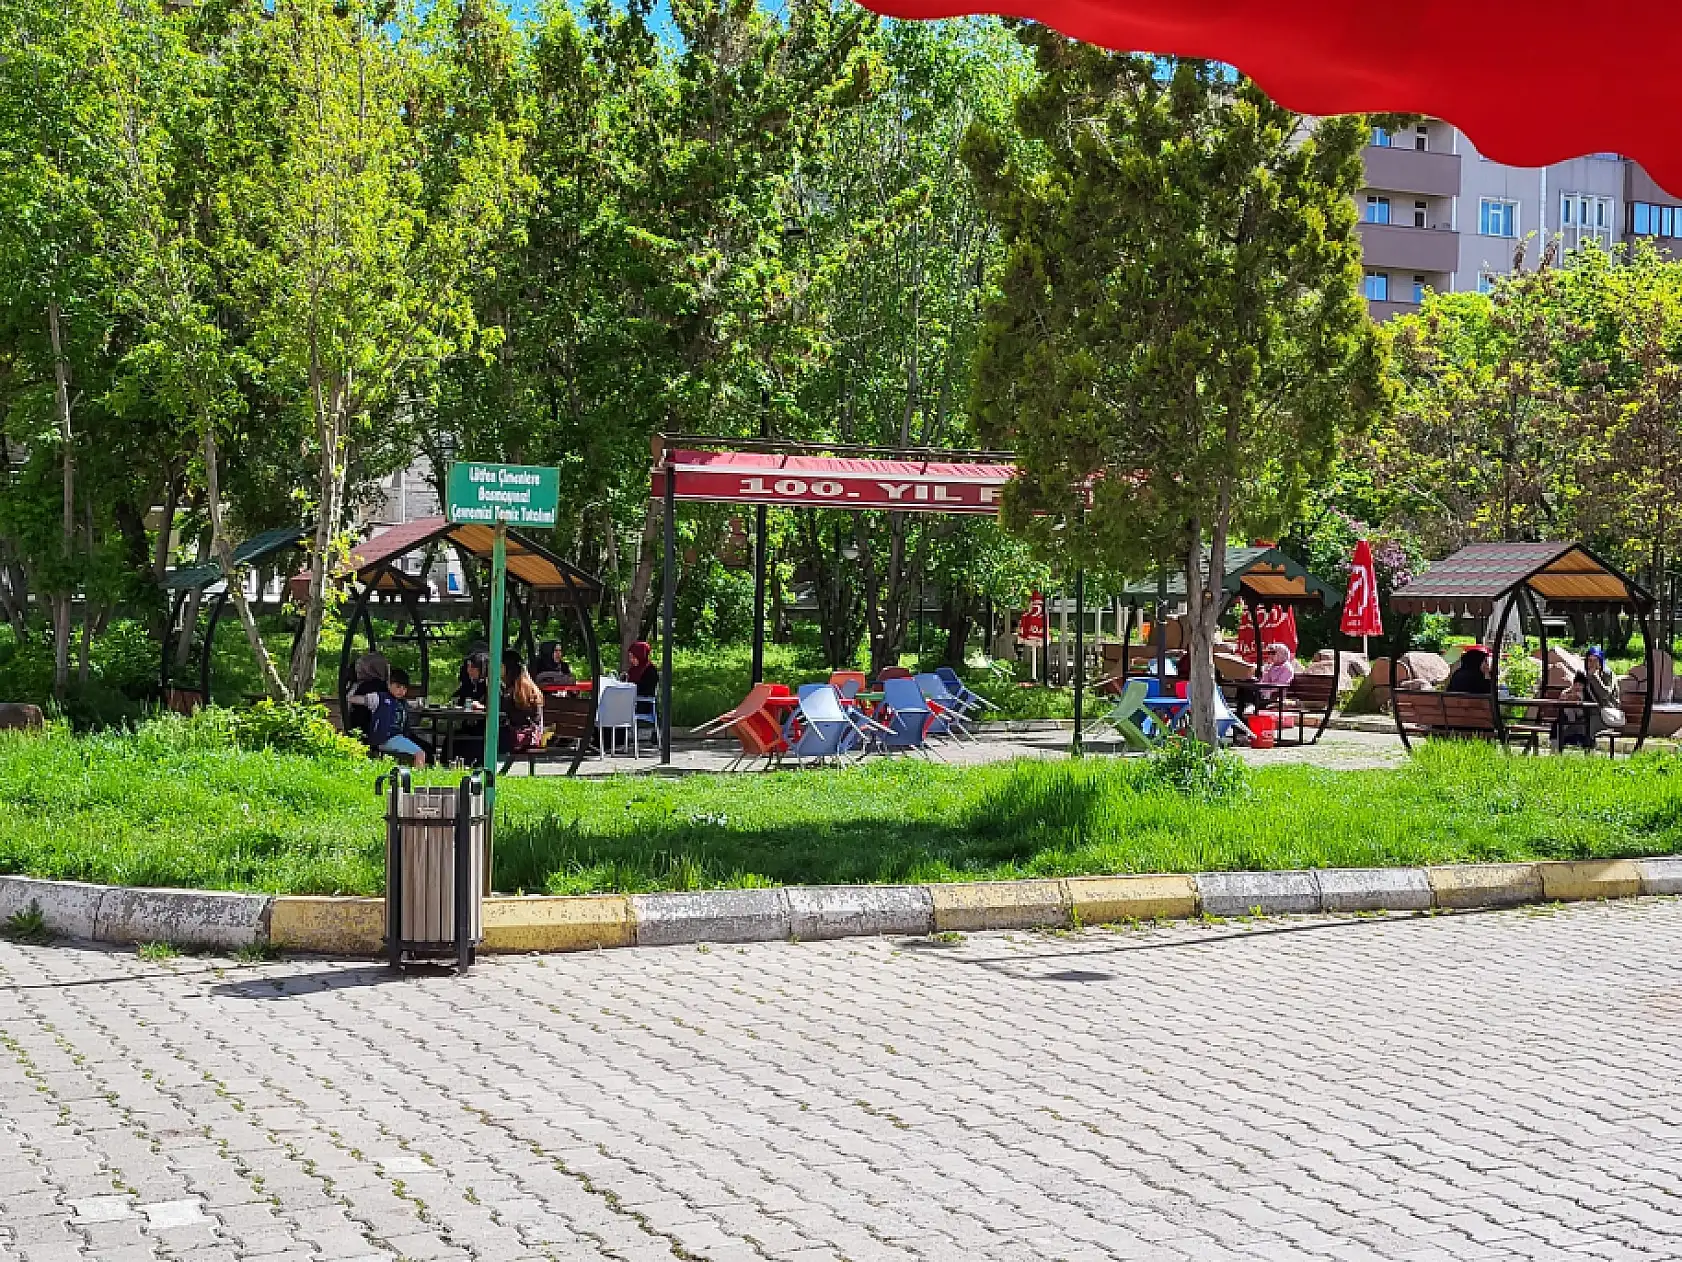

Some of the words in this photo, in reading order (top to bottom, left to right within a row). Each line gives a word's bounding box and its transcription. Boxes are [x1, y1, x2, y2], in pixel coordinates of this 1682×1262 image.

[469, 466, 496, 482] Lütfen
[739, 477, 860, 498] 100.
[877, 482, 962, 501] YIL
[494, 505, 520, 521] Temiz
